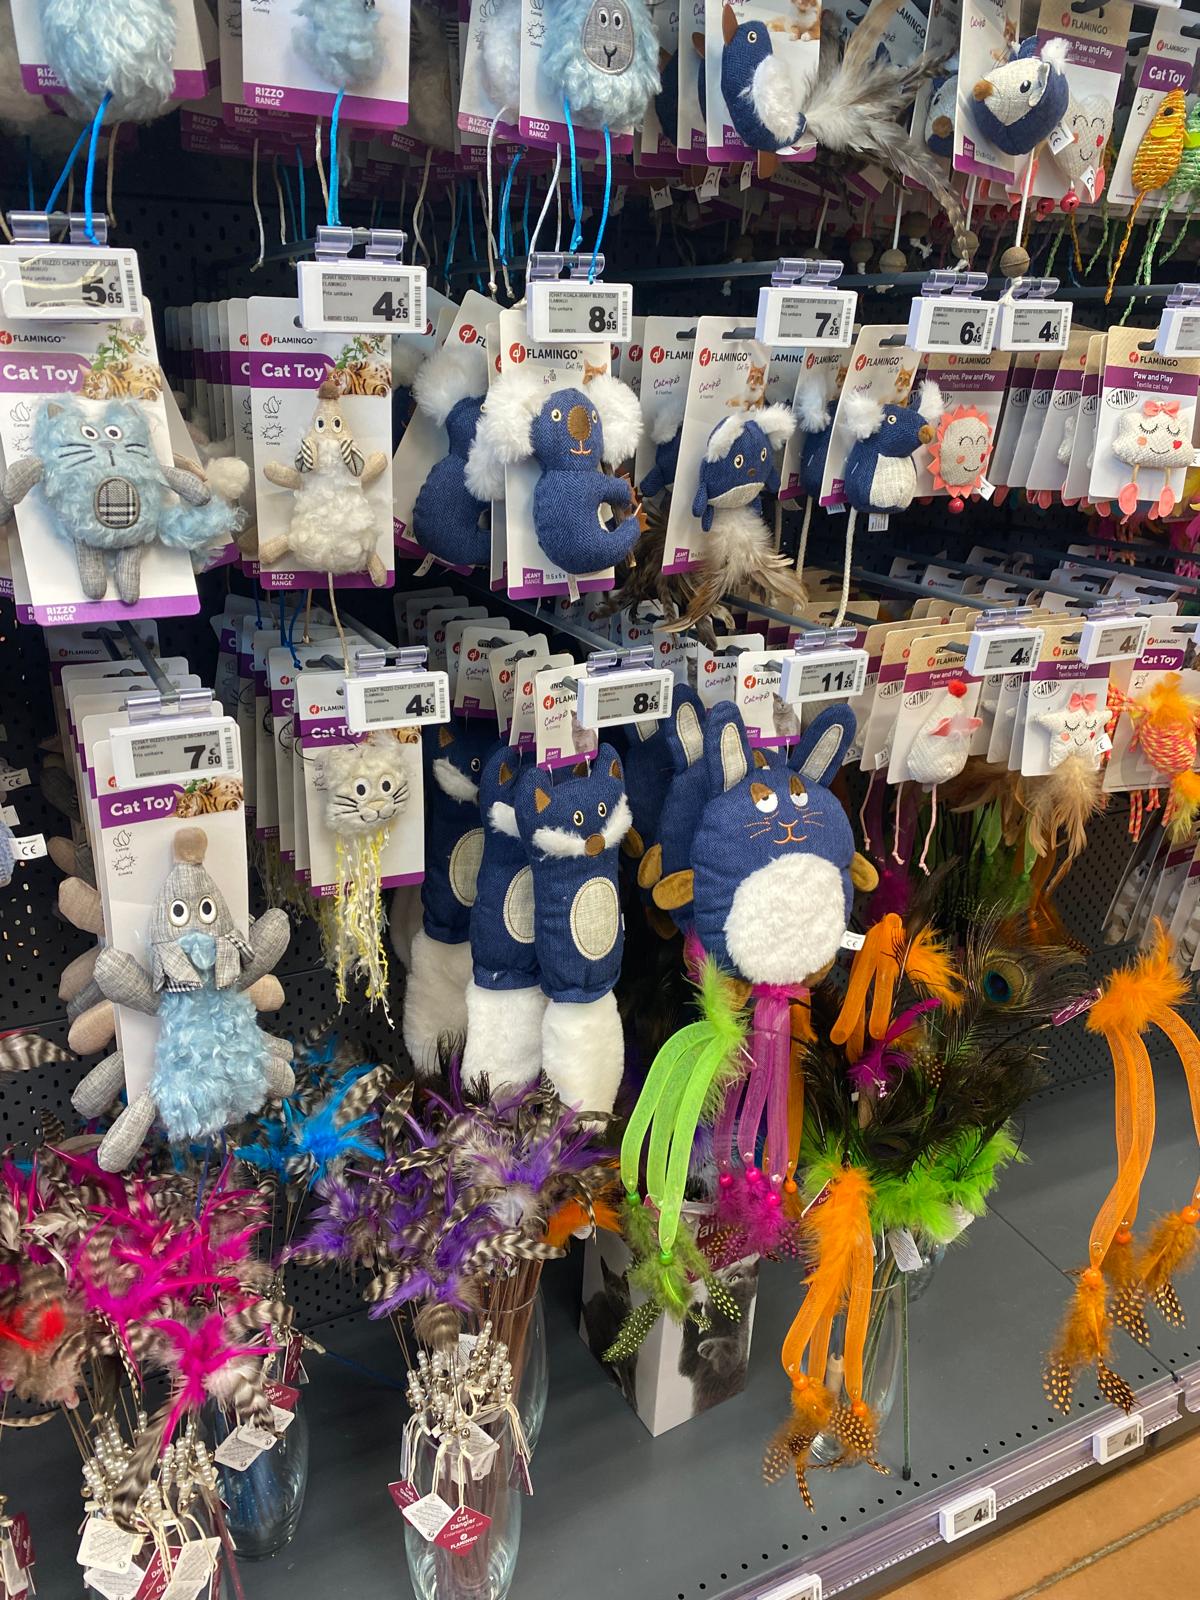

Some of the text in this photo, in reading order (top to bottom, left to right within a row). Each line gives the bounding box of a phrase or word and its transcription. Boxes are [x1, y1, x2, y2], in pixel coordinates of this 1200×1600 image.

[1071, 18, 1108, 35] FLAMINGO
[1075, 41, 1113, 59] Paw and Play
[1149, 66, 1186, 87] Cat Toy
[255, 87, 285, 99] RIZZO
[255, 96, 281, 106] RANGE
[529, 121, 550, 132] RIZZO
[528, 130, 548, 139] RANGE
[725, 131, 740, 140] JEAN
[82, 277, 122, 308] 5 € 65
[373, 292, 409, 321] 4 € 25
[588, 306, 617, 333] 8 € 95
[815, 312, 839, 337] 7 € 25
[959, 321, 982, 345] 6 € 45
[1038, 321, 1059, 342] 4 € 50
[13, 335, 61, 343] FLAMINGO
[273, 337, 313, 345] FLAMINGO
[526, 349, 578, 360] FLAMINGO
[665, 350, 694, 360] FLAMI
[711, 351, 748, 362] FLAMINGO
[957, 355, 991, 365] FLAMINGO
[865, 356, 900, 367] FLAMINGO
[1140, 356, 1178, 367] FLAMINGO
[3, 364, 79, 385] Cat Toy
[261, 362, 290, 378] Cat
[292, 363, 324, 382] Toy
[979, 374, 995, 382] Play
[1134, 371, 1174, 384] Paw and Play
[1111, 390, 1136, 406] CATNIP
[271, 573, 295, 581] RIZZO
[46, 605, 76, 616] RIZZO
[47, 613, 74, 623] RANGE
[1119, 635, 1132, 653] 4
[1010, 647, 1024, 665] 4
[1062, 648, 1078, 657] FLAM
[717, 662, 737, 670] FLAM
[1141, 655, 1178, 666] Cat Toy
[757, 676, 781, 685] FLAMI
[929, 672, 940, 680] Paw
[952, 670, 963, 678] Play
[821, 671, 853, 692] 11 € 25
[1036, 681, 1058, 696] CATNIP
[555, 694, 578, 705] FLAMI
[633, 693, 649, 714] 8
[648, 702, 659, 710] 95
[907, 691, 930, 706] CATNIP
[405, 694, 435, 717] 4 € 65
[311, 727, 336, 739] Cat
[184, 745, 221, 769] 7 € 50
[110, 794, 174, 816] Cat Toy
[22, 845, 37, 856] CE
[1124, 1433, 1132, 1446] 4
[457, 1514, 469, 1522] Cat
[974, 1508, 982, 1522] 4
[450, 1517, 476, 1530] Dangler
[450, 1535, 478, 1549] FLAMINGO
